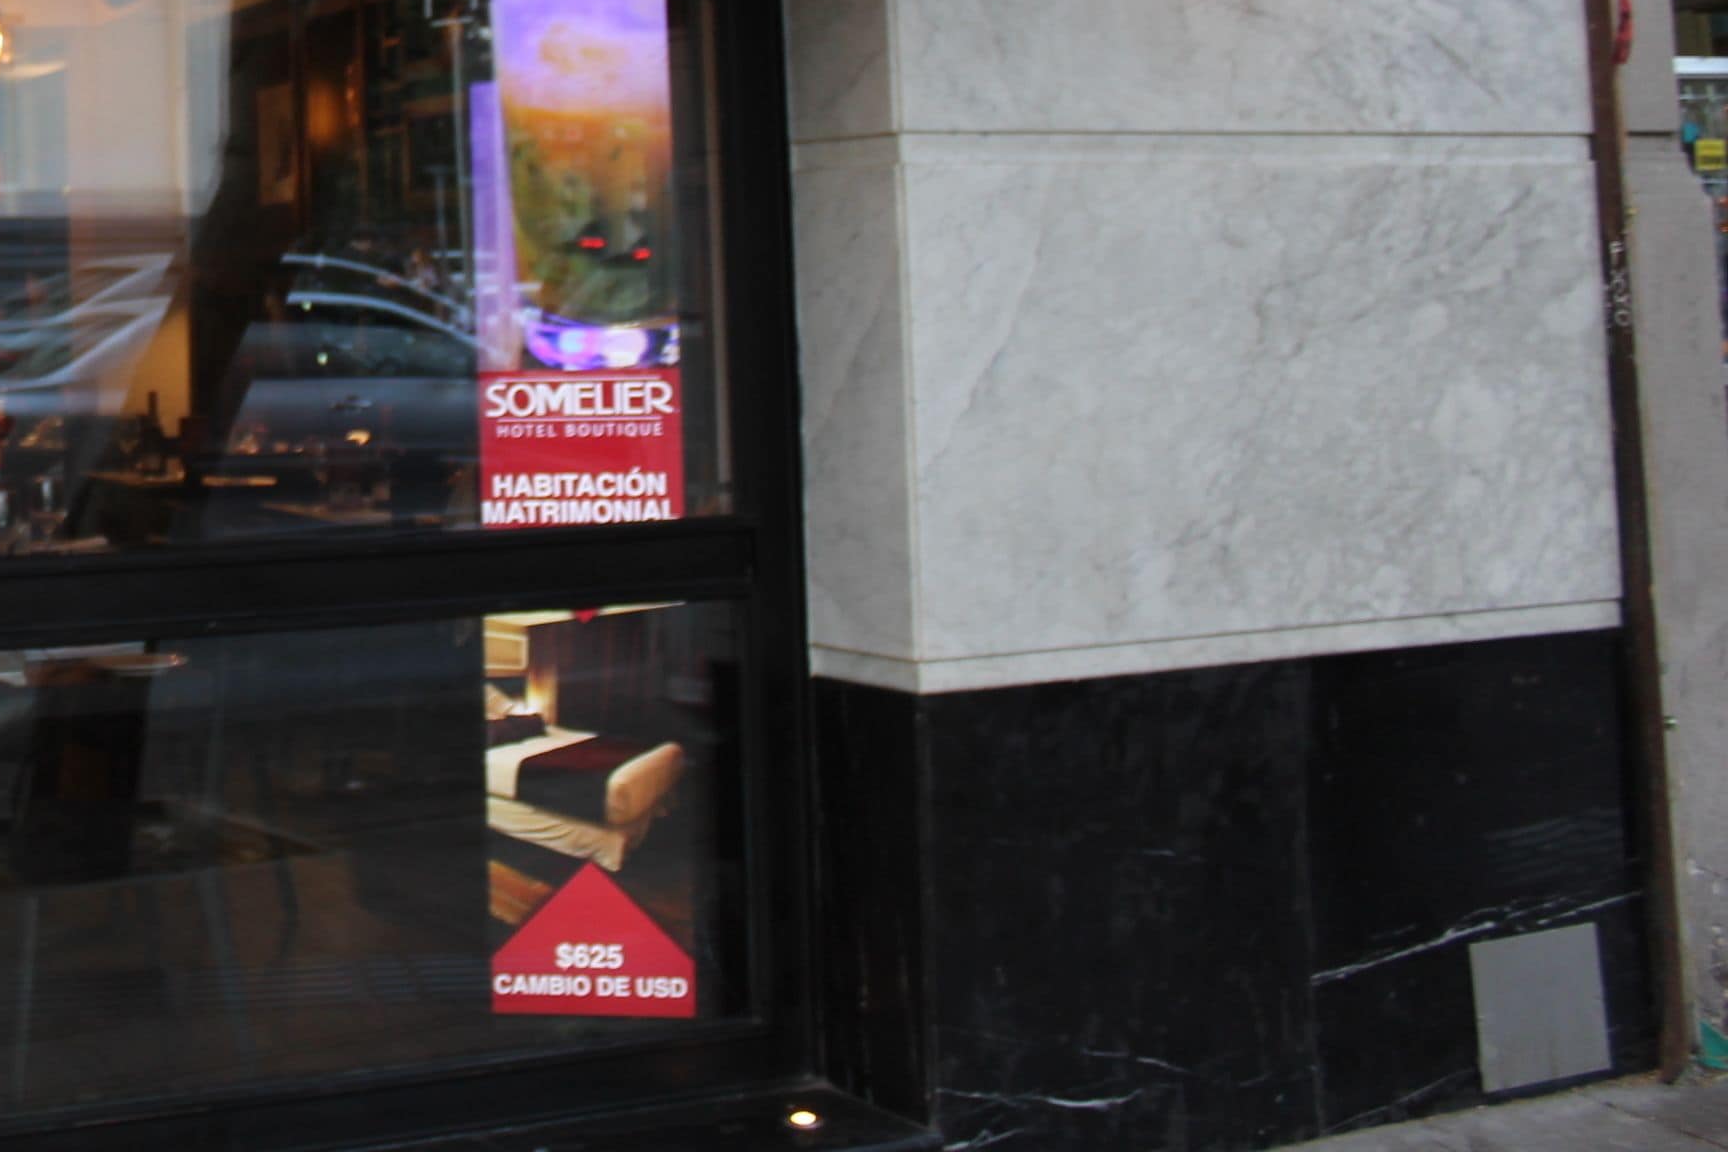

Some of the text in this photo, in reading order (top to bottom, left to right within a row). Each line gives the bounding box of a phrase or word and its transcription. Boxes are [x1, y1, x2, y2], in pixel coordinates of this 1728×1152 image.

[486, 381, 674, 417] SOMELIER
[496, 421, 664, 439] HOTEL BOUTIQUE
[492, 466, 667, 498] HABITACIÓN
[481, 501, 678, 524] MATRIMONIAL
[555, 942, 625, 970] $625
[493, 974, 689, 998] CAMBIO DE USD
